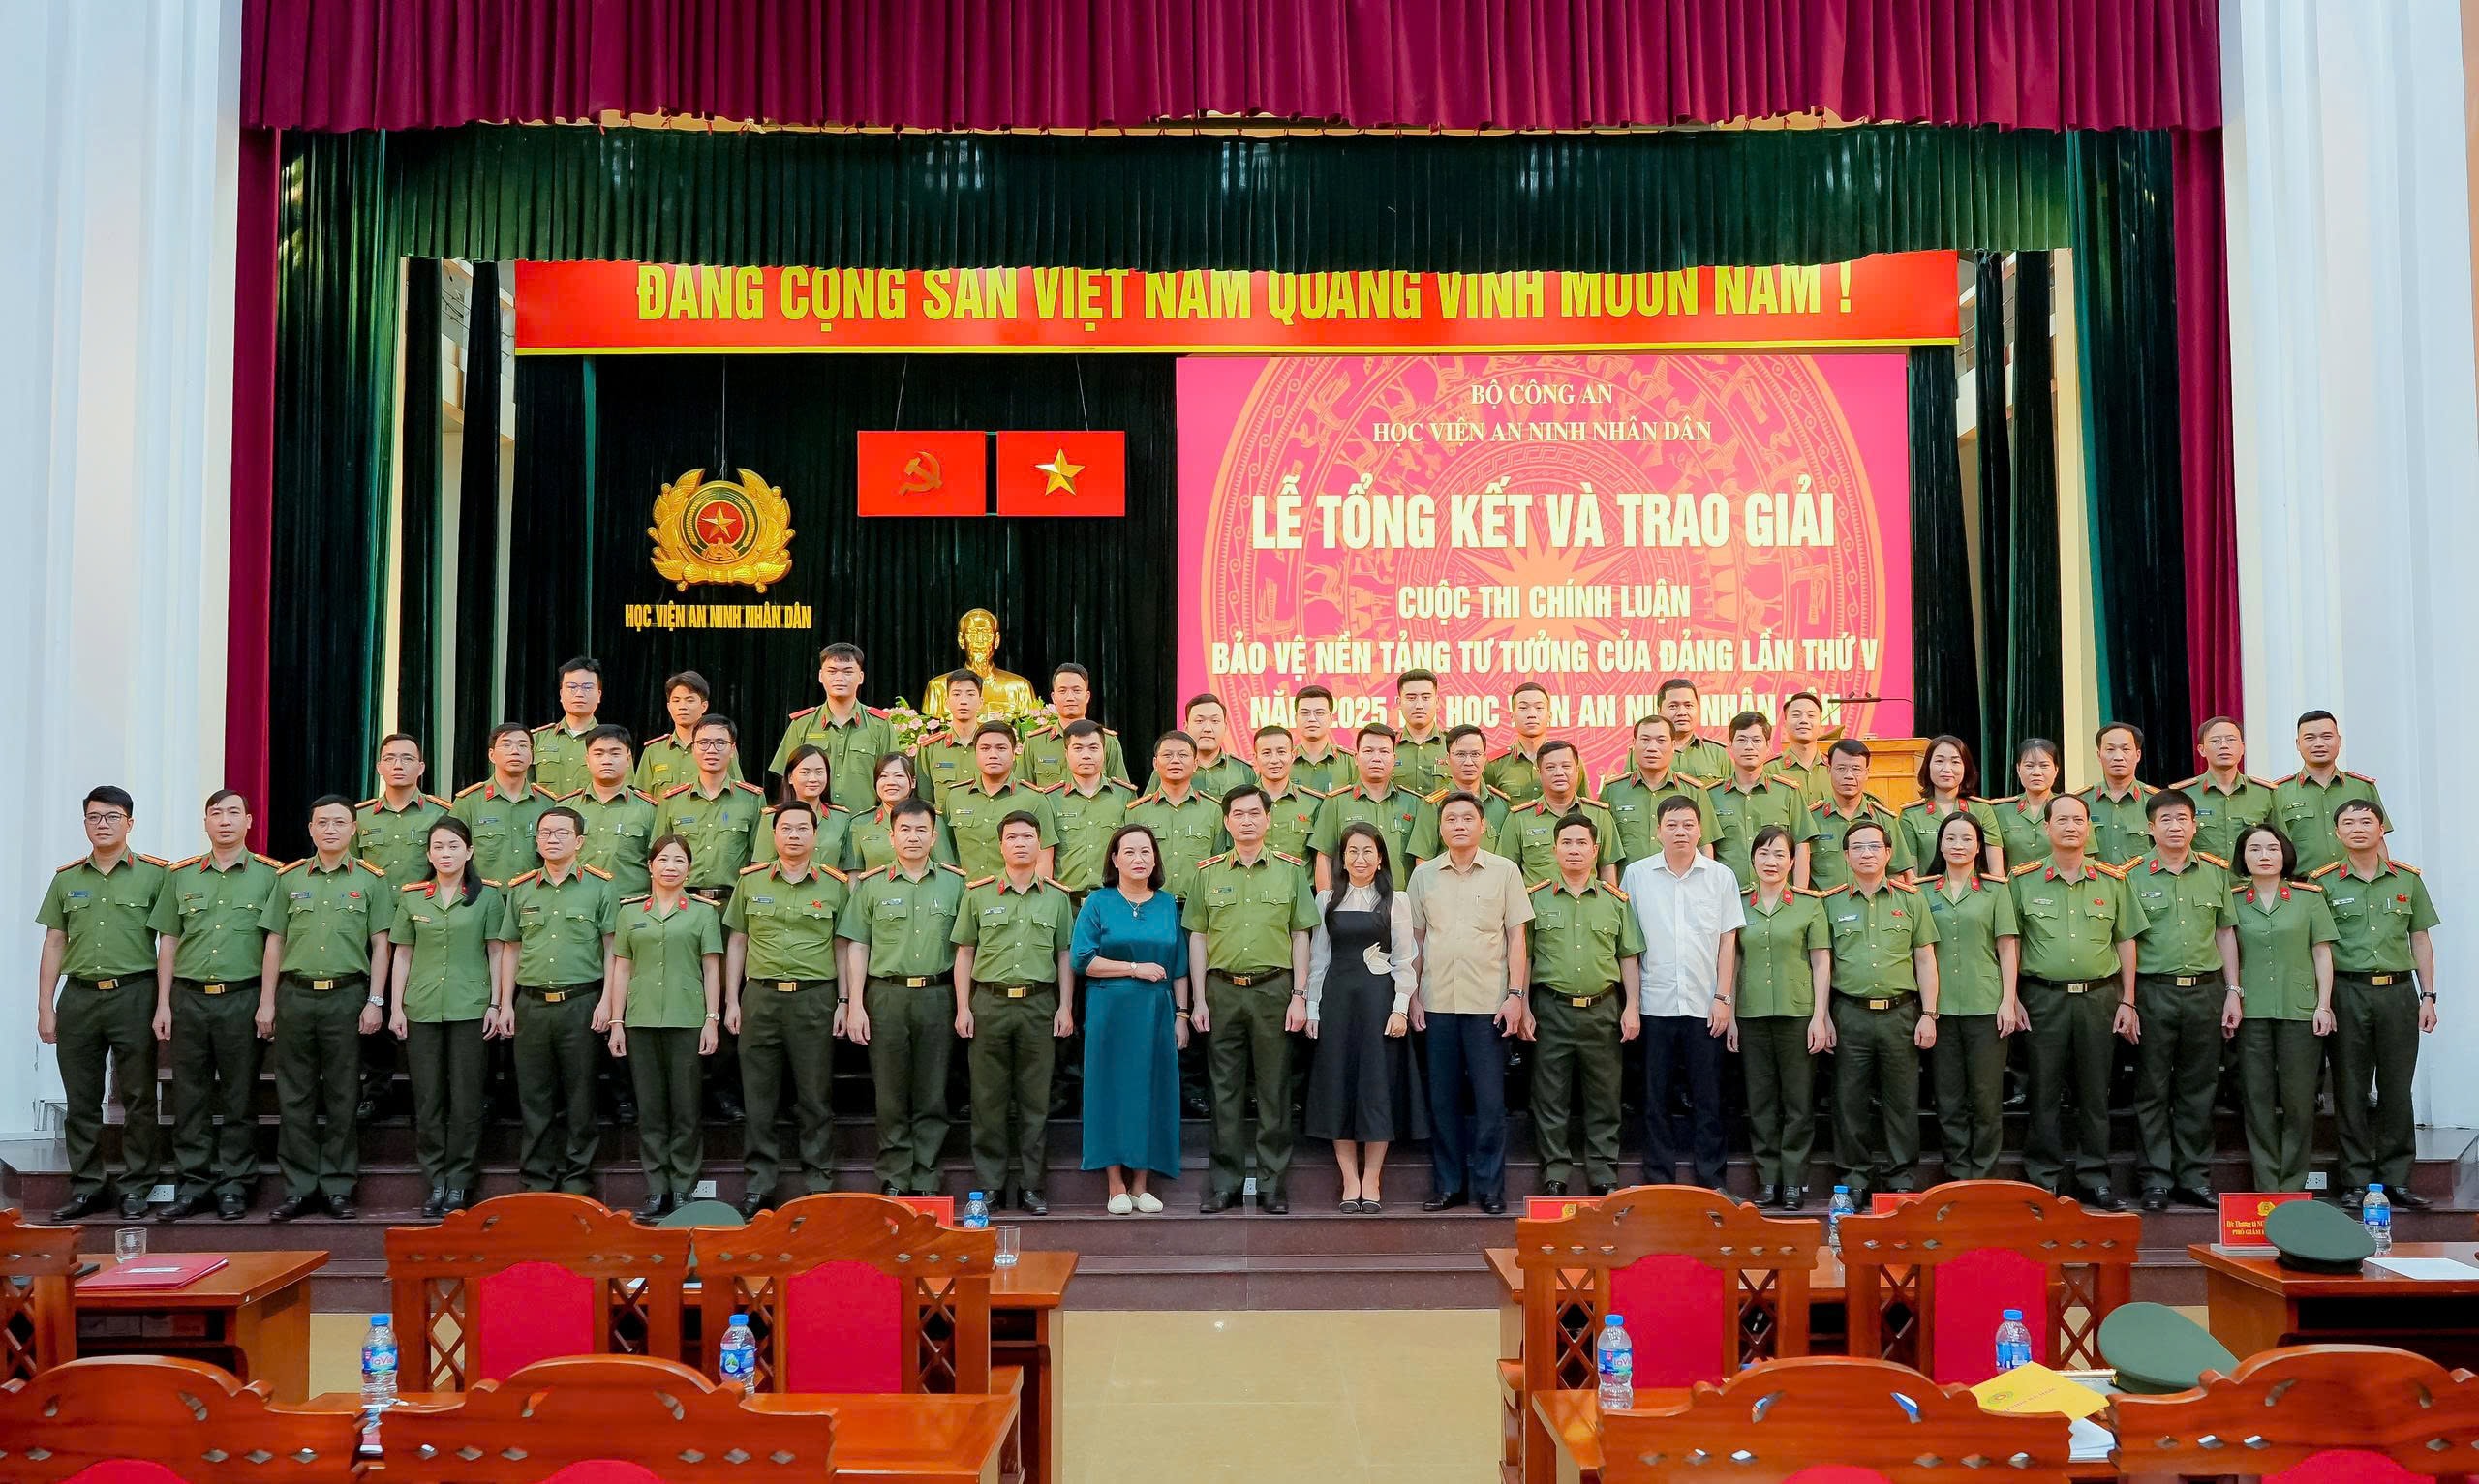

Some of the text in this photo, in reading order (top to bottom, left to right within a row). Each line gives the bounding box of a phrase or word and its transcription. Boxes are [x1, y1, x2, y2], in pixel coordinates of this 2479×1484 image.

[1145, 268, 1251, 318] NAM
[1268, 269, 1422, 326] QUANG
[1437, 270, 1545, 318] VINH
[1471, 379, 1613, 410] BỘ CÔNG AN
[1372, 415, 1712, 448] HỌC VIỆN AN NINH NHÂN DÂN
[1252, 472, 1835, 549] LỄ TỔNG KẾT VÀ TRAO GIẢI
[625, 599, 811, 632] HỌC VIỆN AN NINH NHÂN DÂN
[1398, 578, 1691, 625] CUỘC THI CHÍNH LUẬN
[1211, 627, 1879, 681] BẢO VỆ NỀN TẢNG TƯ TƯỞNG CỦA ĐẢNG LẦN THỨ V
[1250, 689, 1298, 729] NĂ
[1577, 694, 1617, 728] AN
